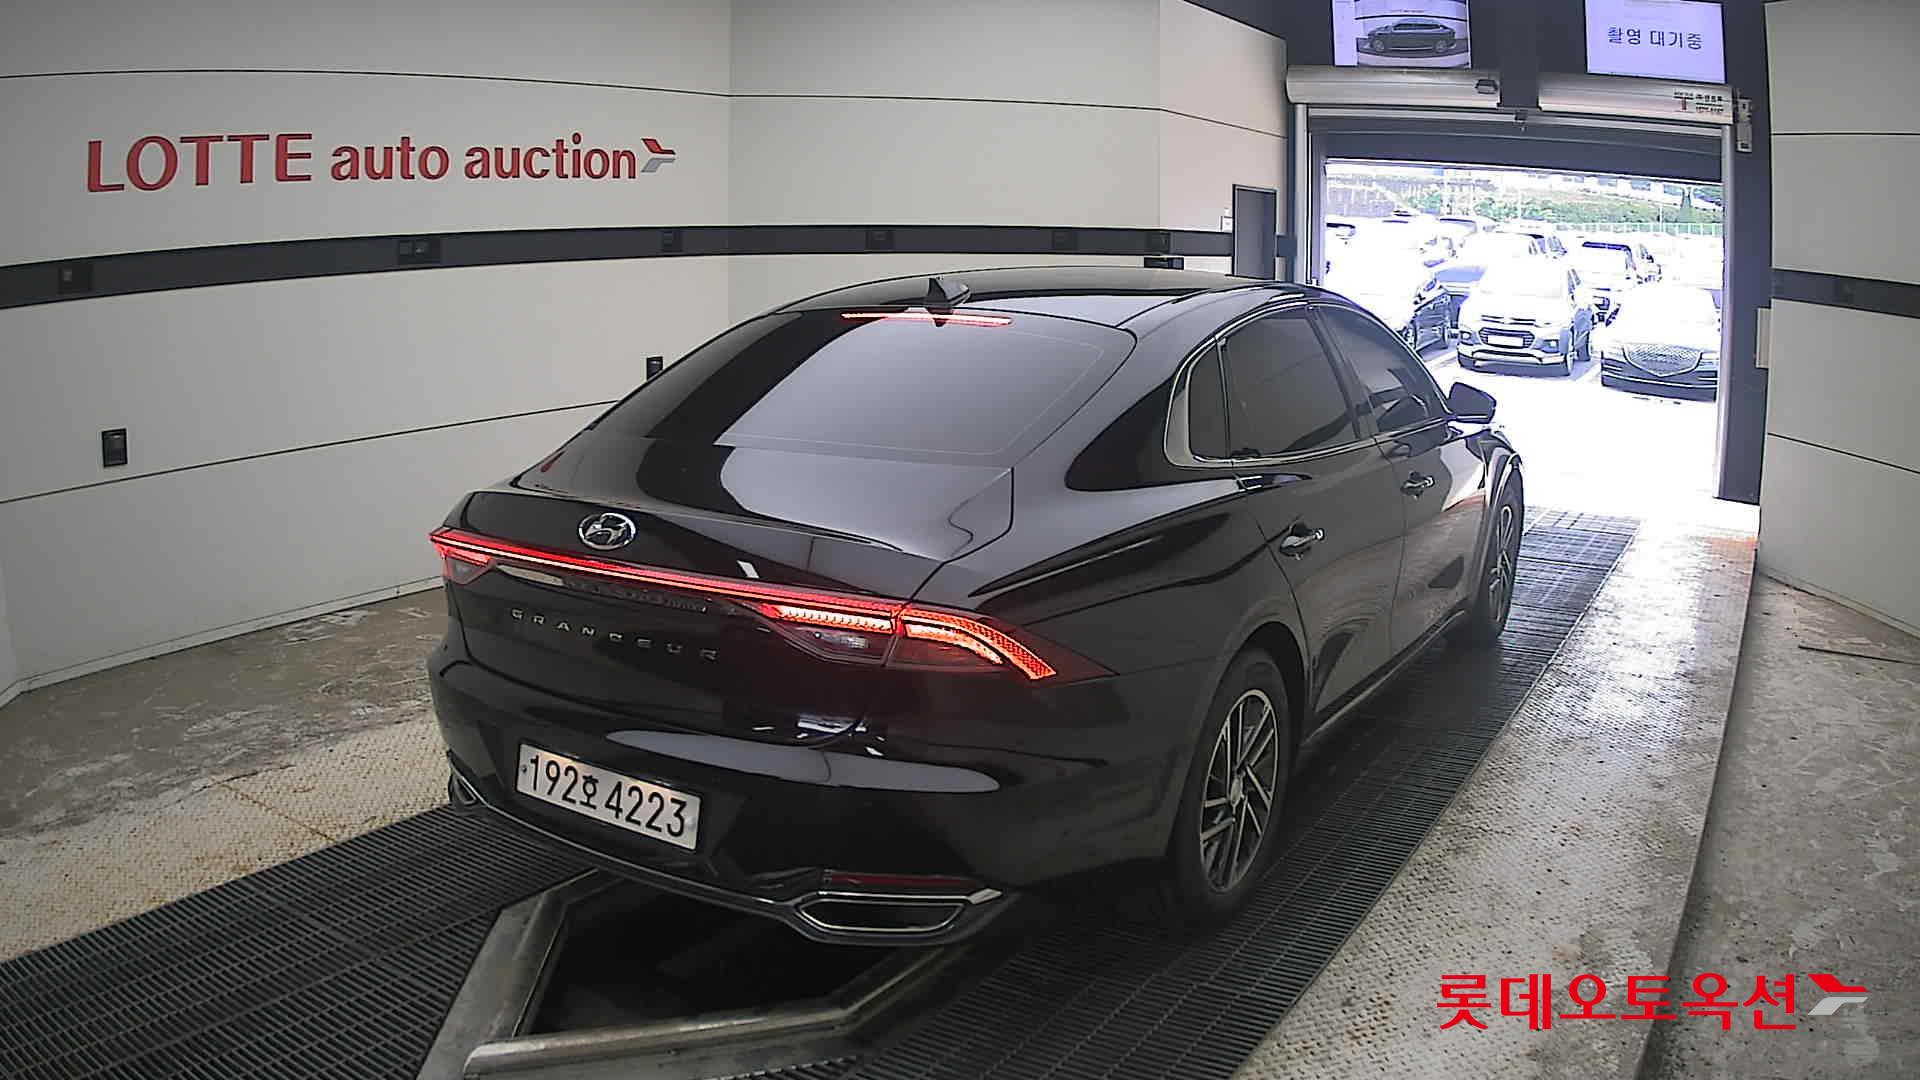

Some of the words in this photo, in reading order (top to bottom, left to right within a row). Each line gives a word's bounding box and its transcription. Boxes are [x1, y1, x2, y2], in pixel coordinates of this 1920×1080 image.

[1649, 30, 1702, 50] 대기중
[88, 133, 312, 192] LOTTE
[331, 136, 450, 180] auto
[464, 132, 637, 179] auction
[511, 608, 718, 660] GRANDEUR
